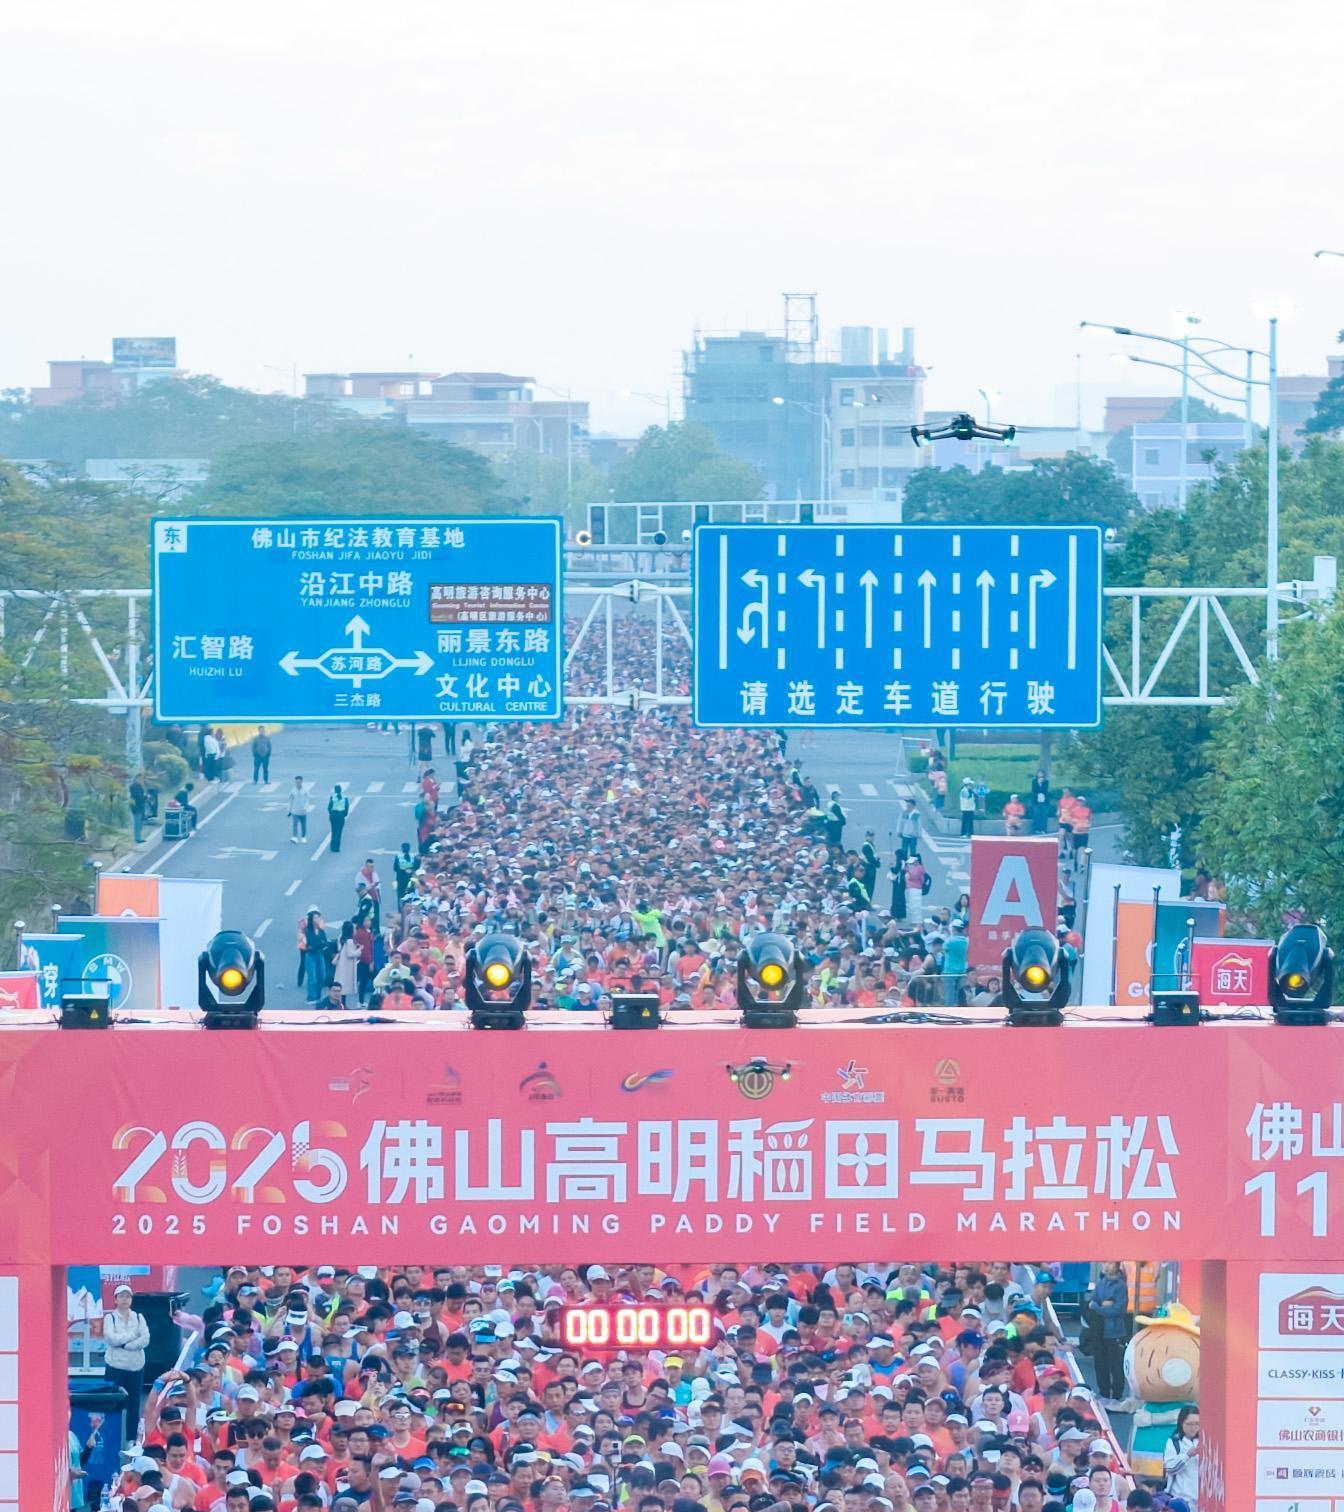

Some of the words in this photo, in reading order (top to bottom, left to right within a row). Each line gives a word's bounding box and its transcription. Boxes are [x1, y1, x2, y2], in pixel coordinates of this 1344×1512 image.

[164, 526, 182, 544] 东
[251, 526, 465, 549] 佛山市纪法教育基地
[291, 551, 334, 560] FOSHAN
[338, 551, 361, 560] JIFA
[365, 550, 404, 560] JIAOYU
[412, 550, 432, 560] JIDI
[299, 571, 413, 597] 沿江中路
[431, 586, 550, 600] 高明旅游咨询服务中心
[301, 598, 356, 607] YANJIANG
[359, 598, 410, 608] ZHONGLU
[172, 635, 254, 660] 汇智路
[436, 628, 550, 654] 丽景东路
[189, 667, 225, 677] HUIZHI
[229, 667, 242, 677] LU
[331, 656, 382, 672] 苏河路
[453, 658, 486, 667] LIJING
[491, 658, 534, 667] DONGLU
[436, 673, 552, 699] 文化中心
[333, 693, 382, 707] 三杰路
[439, 702, 496, 711] CULTURAL
[506, 702, 548, 711] CENTRE
[739, 679, 1056, 716] 请选定车道行驶
[982, 856, 1044, 926] A
[1217, 969, 1248, 990] 海天
[112, 1214, 207, 1235] 2025
[237, 1214, 399, 1235] FOSHAN
[430, 1213, 620, 1235] GAOMING
[650, 1213, 780, 1234] PADDY
[810, 1212, 927, 1233] FIELD
[957, 1210, 1182, 1233] MARATHON
[566, 1309, 609, 1344] 00
[616, 1309, 659, 1344] 00
[667, 1308, 710, 1343] 00
[1288, 1304, 1344, 1331] 海天
